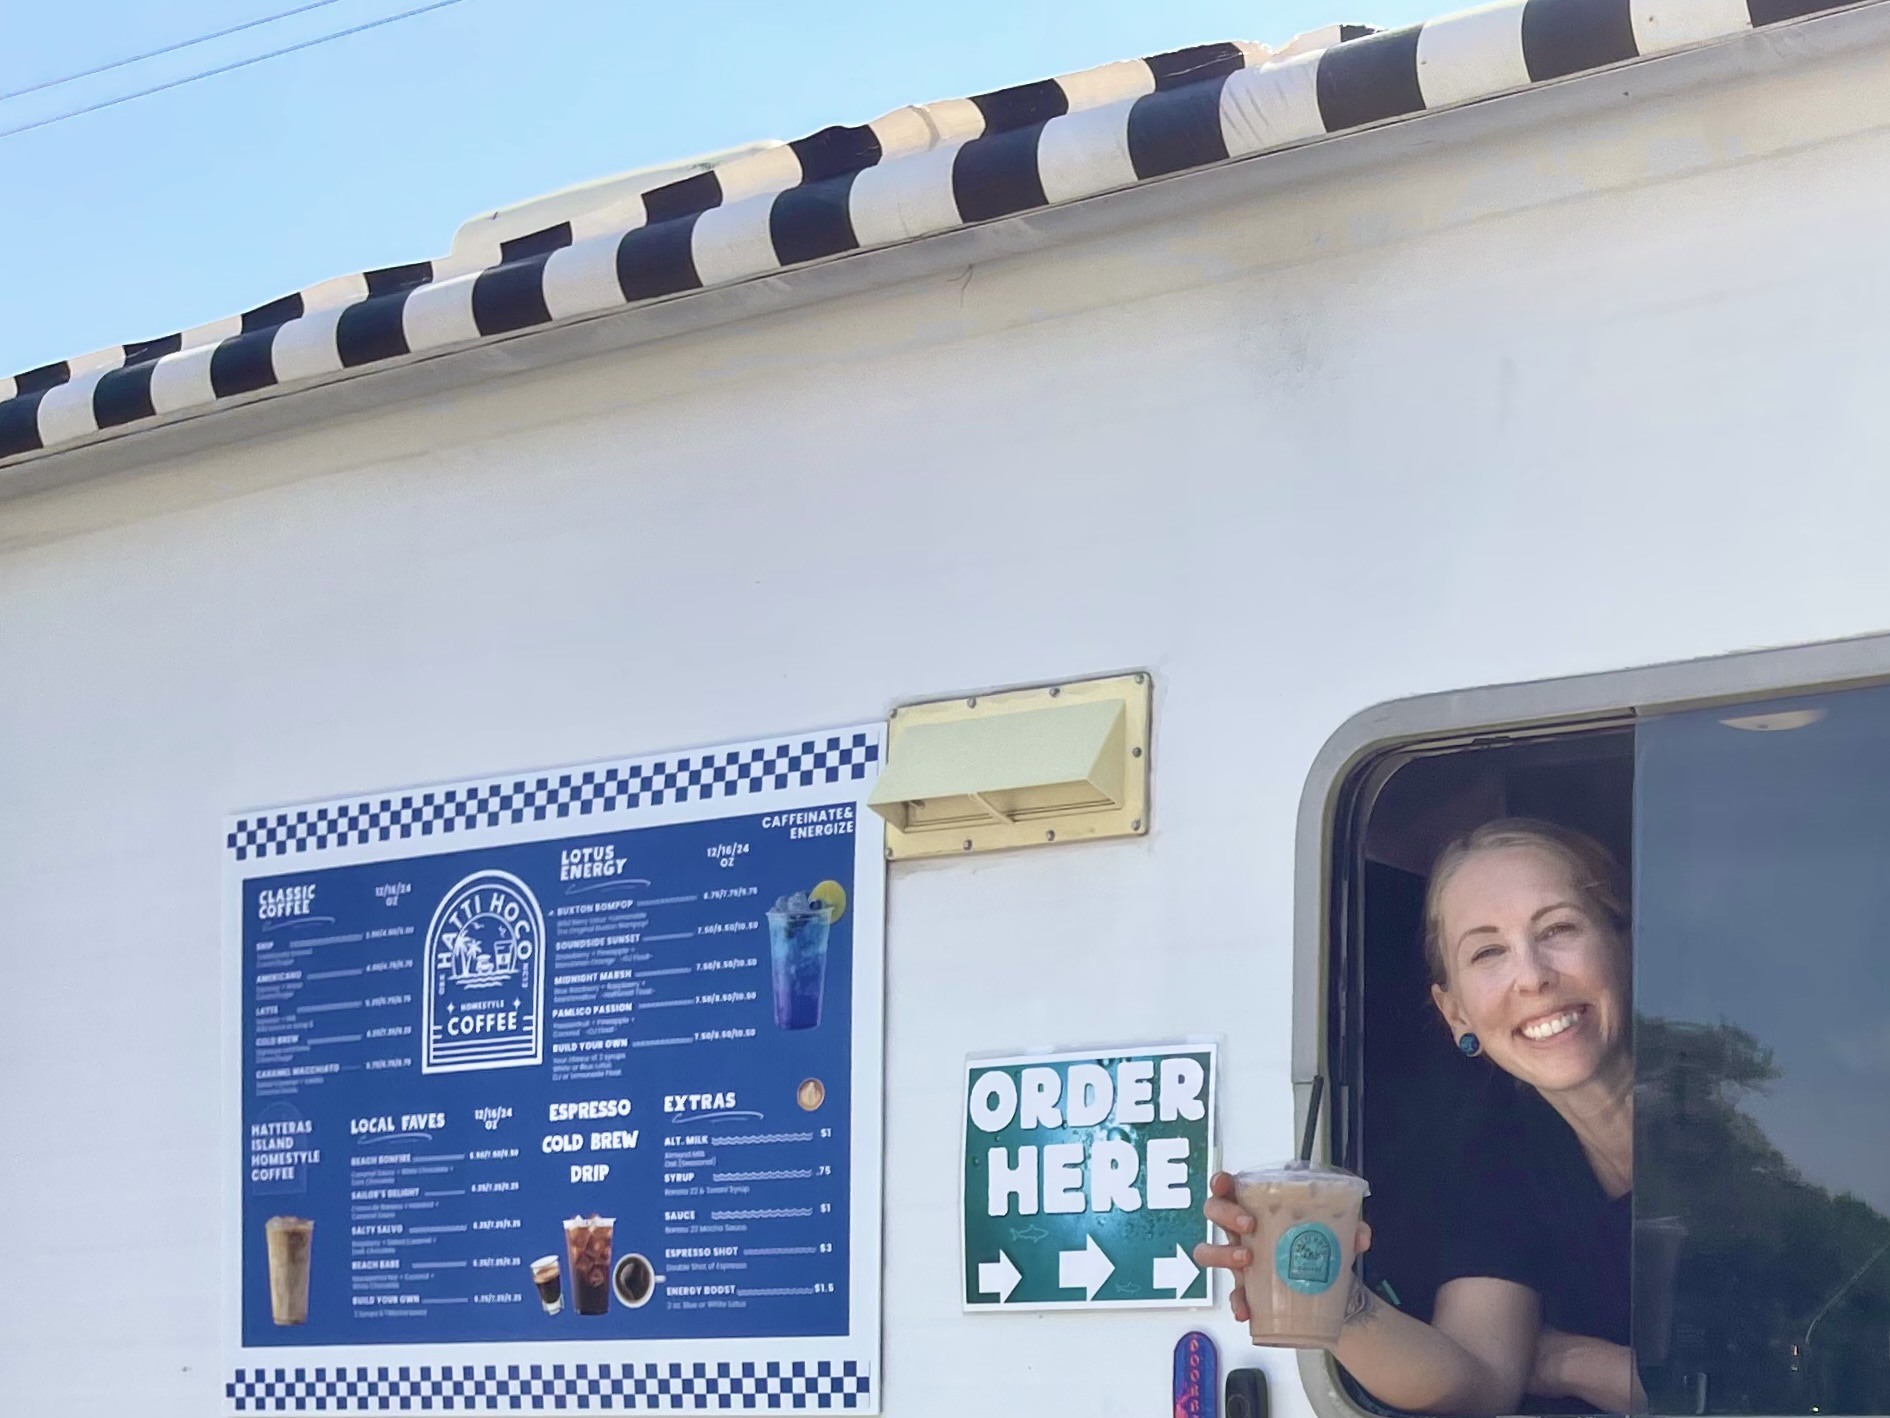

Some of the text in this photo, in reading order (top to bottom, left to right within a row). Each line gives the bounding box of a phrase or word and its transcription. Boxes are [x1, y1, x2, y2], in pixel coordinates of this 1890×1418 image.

[762, 807, 853, 829] CAFFEINATE&
[790, 821, 854, 840] ENERGIZE
[561, 845, 615, 864] LOTUS
[560, 858, 627, 881] ENERGY
[259, 884, 316, 905] CLASSIC
[259, 902, 310, 920] COFFEE
[664, 1092, 736, 1113] EXTRAS
[969, 1057, 1205, 1132] ORDER
[550, 1099, 632, 1122] ESPRESSO
[251, 1120, 312, 1136] HATTERAS
[351, 1112, 445, 1135] LOCAL FAVES
[251, 1137, 293, 1150] ISLAND
[542, 1130, 639, 1154] COLD BREW
[251, 1150, 320, 1167] HOMESTYLE
[251, 1167, 294, 1181] COFFEE
[571, 1165, 610, 1183] DRIP
[987, 1137, 1192, 1216] HERE
[665, 1247, 738, 1258] ESPRESSO SHOT
